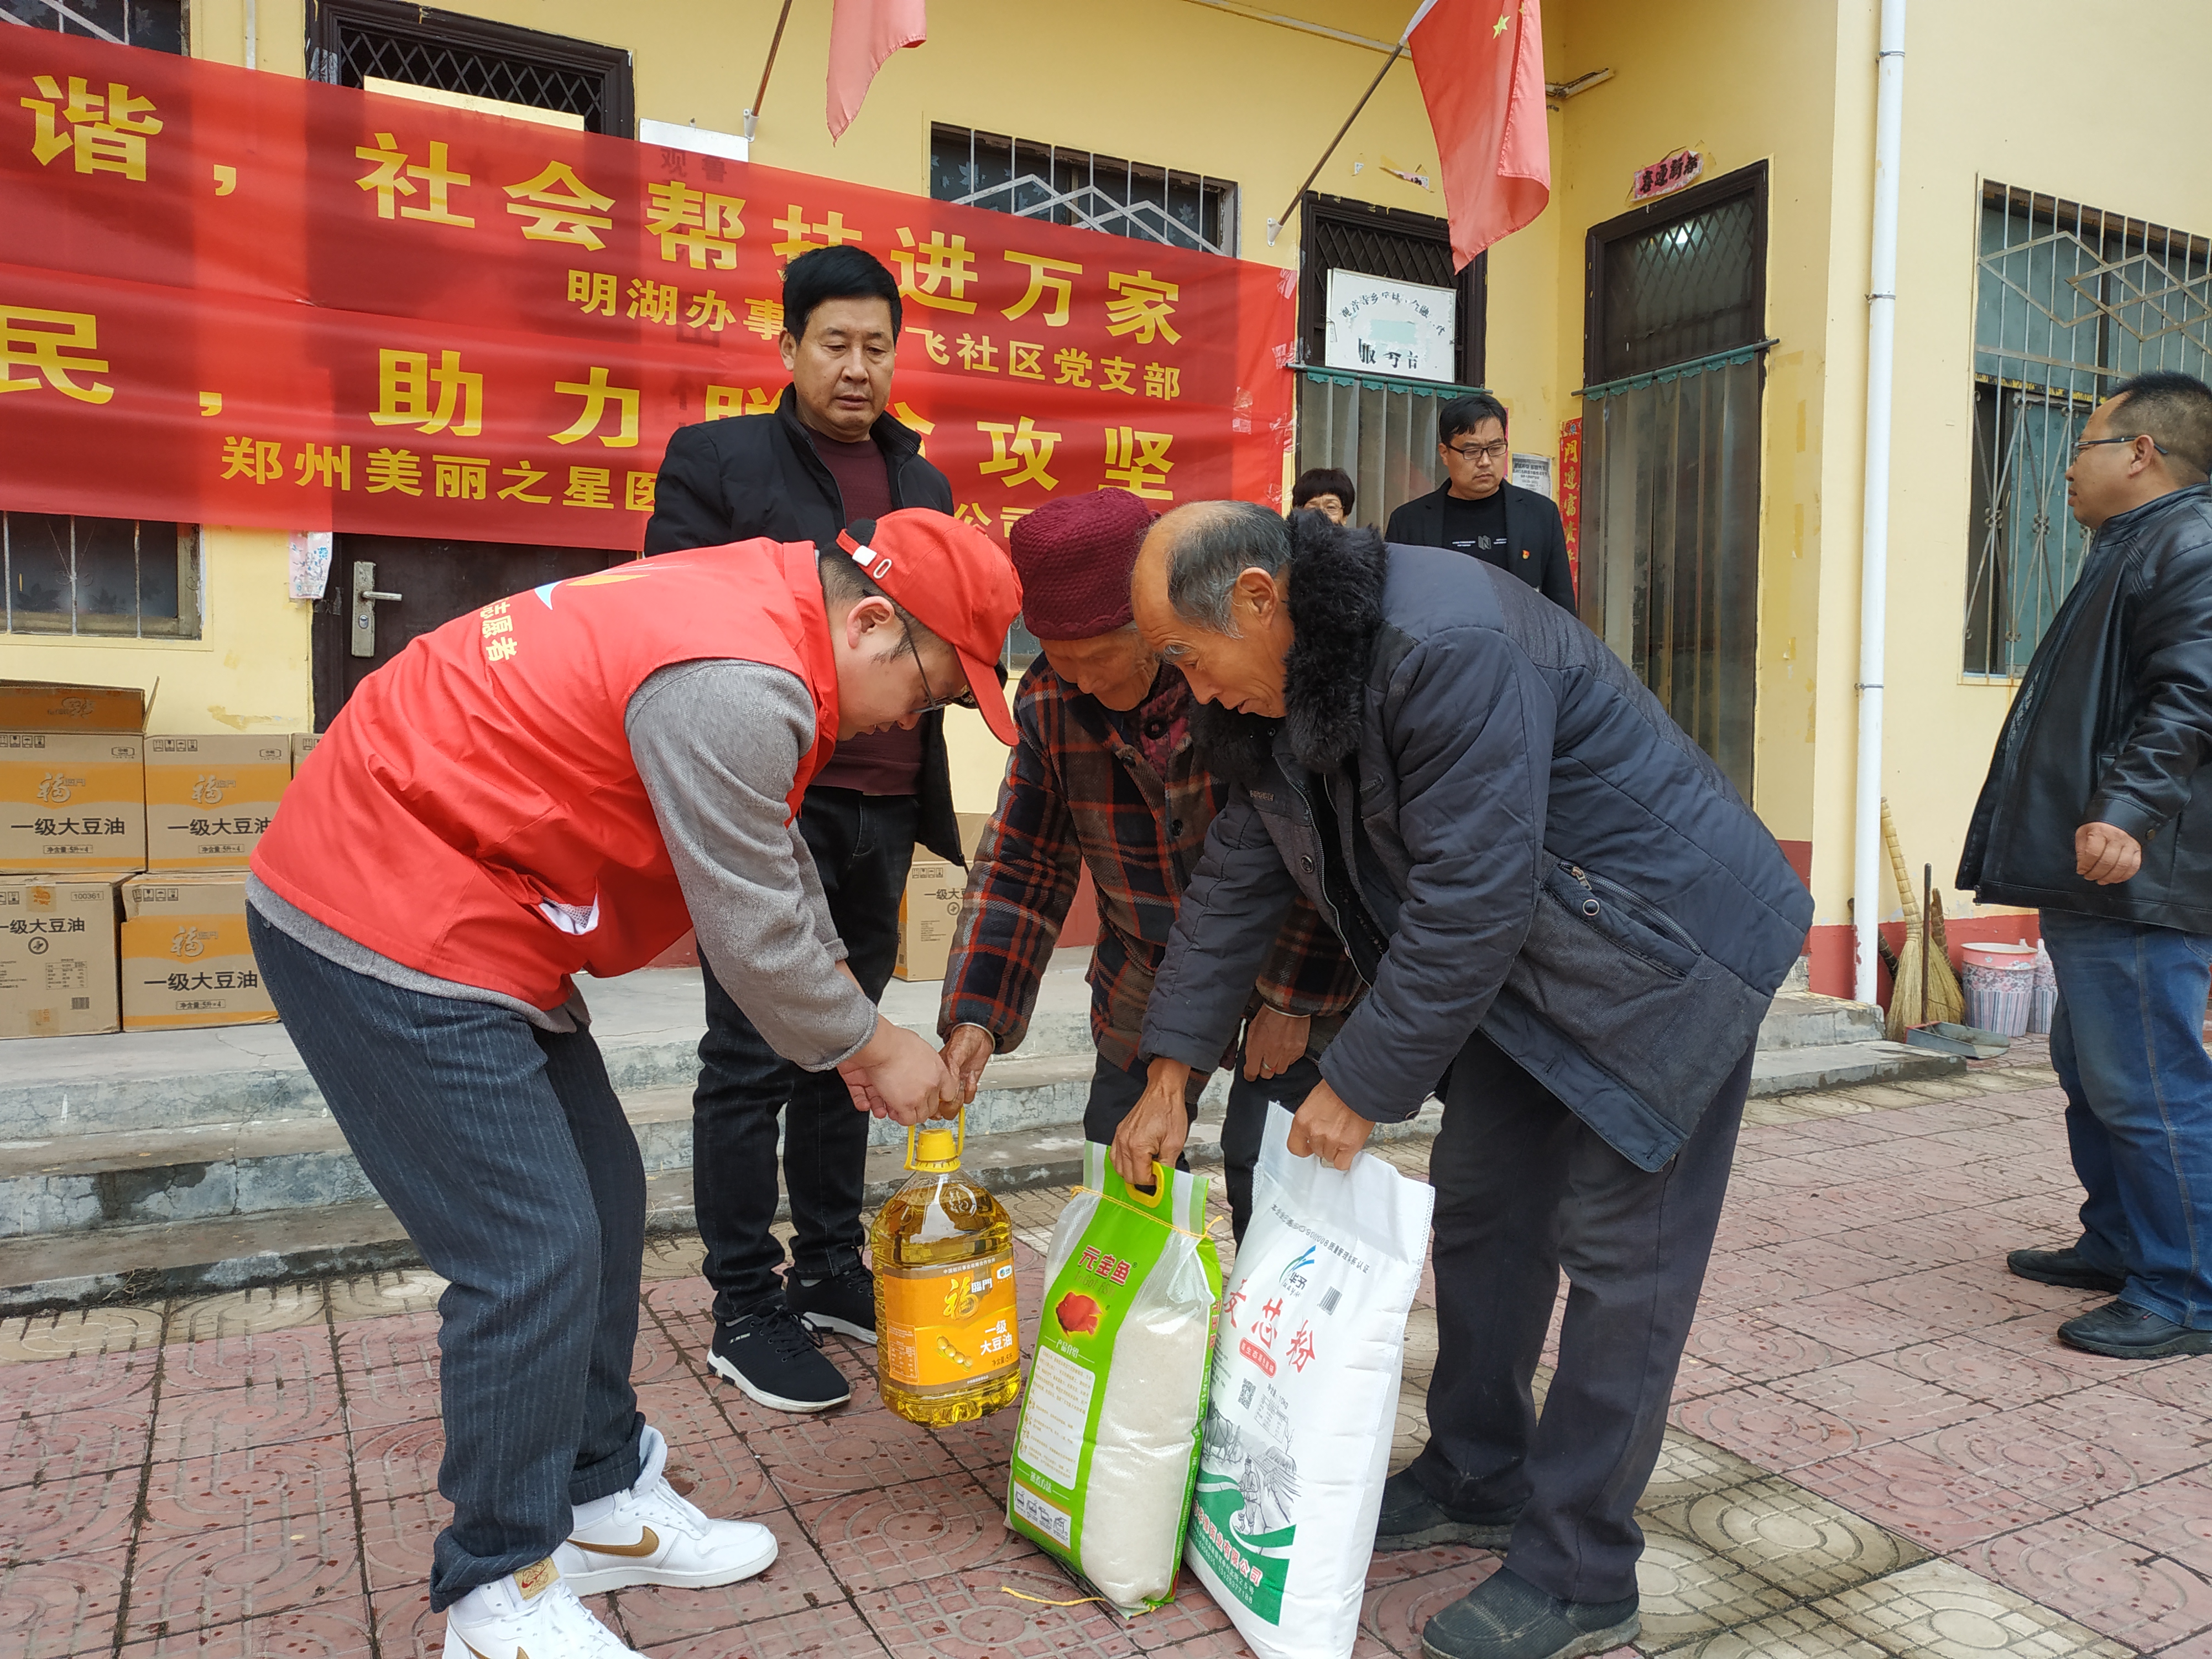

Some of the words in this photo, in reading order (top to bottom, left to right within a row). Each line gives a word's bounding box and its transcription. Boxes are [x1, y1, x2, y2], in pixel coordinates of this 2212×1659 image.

[11, 817, 125, 836] 一级大豆油
[144, 970, 258, 991] 一级大豆油
[1078, 1245, 1131, 1287] 元宝鱼
[985, 1319, 1008, 1334] 一级
[980, 1332, 1013, 1356] 大豆油
[1056, 1339, 1079, 1358] 产品介绍
